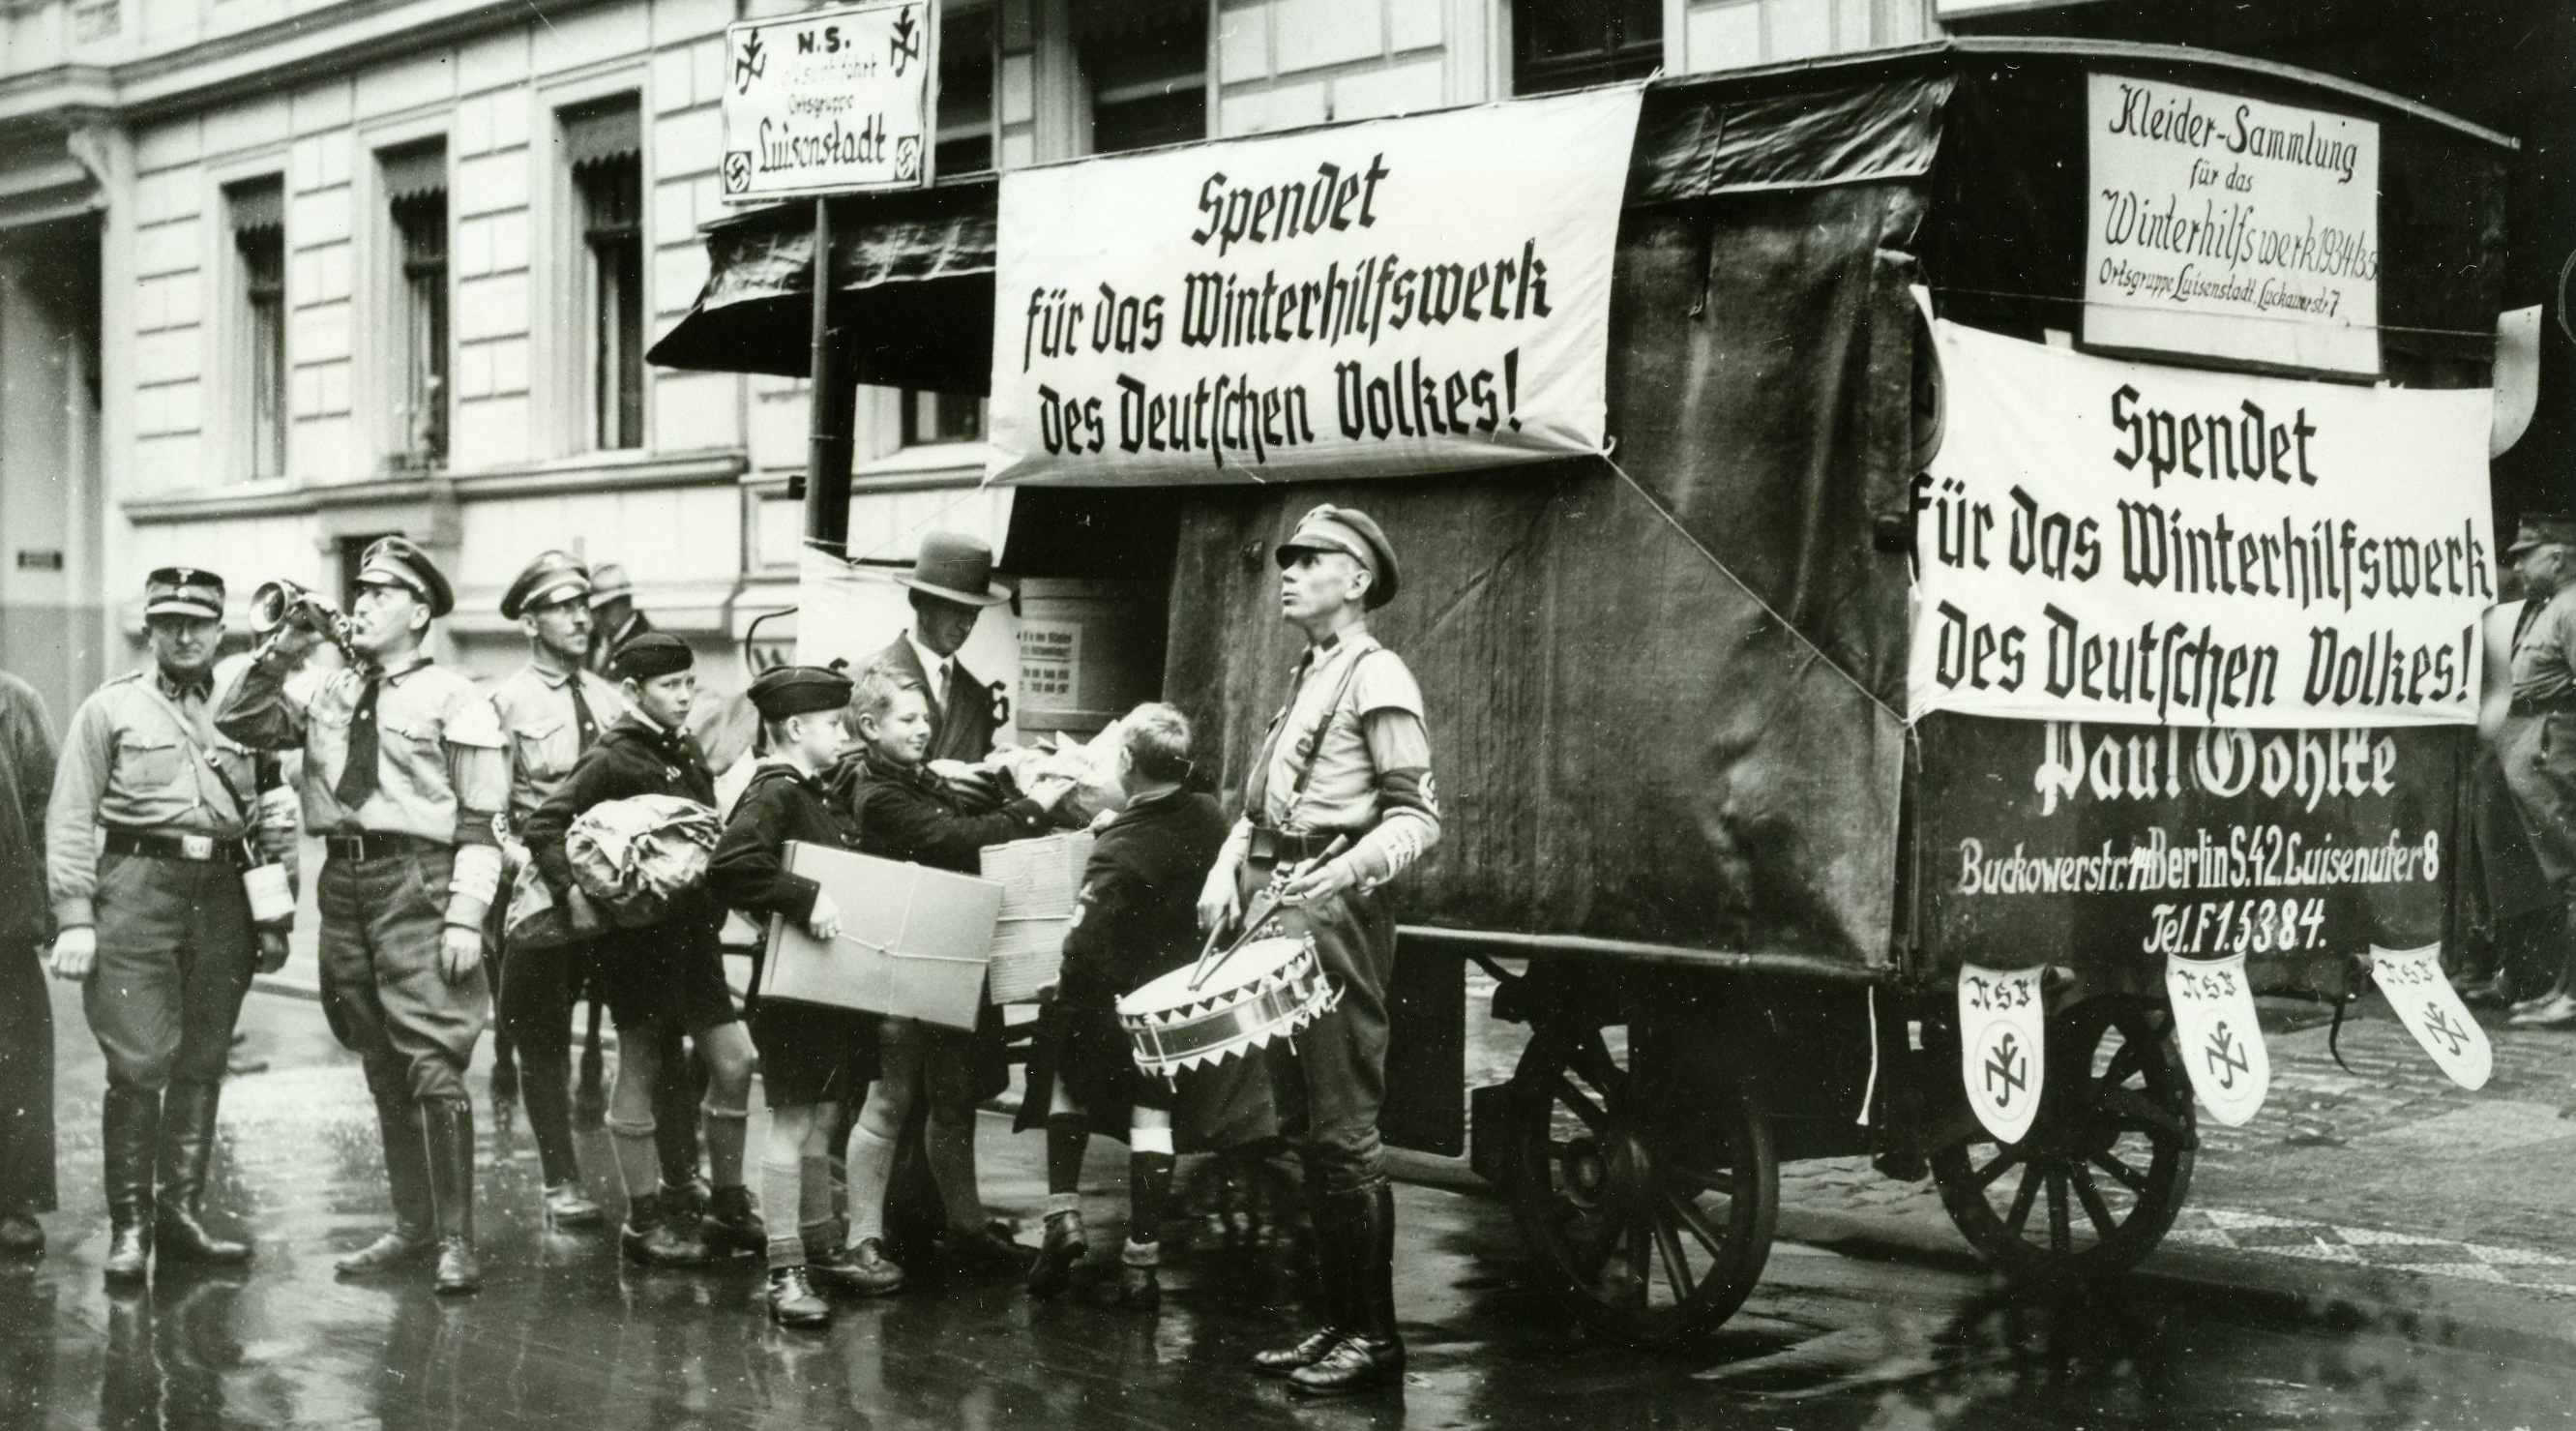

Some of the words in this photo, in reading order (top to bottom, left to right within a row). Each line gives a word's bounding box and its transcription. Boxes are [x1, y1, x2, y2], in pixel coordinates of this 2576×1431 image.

[798, 26, 850, 54] N.S.
[759, 112, 886, 173] Luisenstadt
[2109, 83, 2358, 184] Kleider-Sammlung
[2189, 158, 2218, 190] für
[2225, 162, 2253, 193] das
[1191, 152, 1390, 256] Spendet
[2101, 189, 2315, 272] Winterhilfswerk
[1023, 286, 1084, 373] für
[1091, 282, 1164, 354] das
[1181, 237, 1552, 347] Winterhilfswerk
[2099, 257, 2174, 296] Ortsgruppe
[1038, 384, 1103, 455] des
[1116, 372, 1314, 468] Deutschen
[1335, 347, 1523, 441] Volkes!
[2111, 383, 2318, 489] Spendet
[1910, 471, 1994, 581] für
[2009, 484, 2101, 582] das
[2116, 497, 2495, 613] Winterhilfswerk
[1936, 599, 2027, 694] des
[2042, 602, 2279, 726] Deutschen
[2302, 624, 2474, 708] Volkes!
[2034, 721, 2180, 817] Paul
[2147, 826, 2228, 889] Berlin
[2283, 828, 2423, 885] Luisenufer
[2423, 830, 2440, 881] 8
[2143, 903, 2192, 954] Tel.
